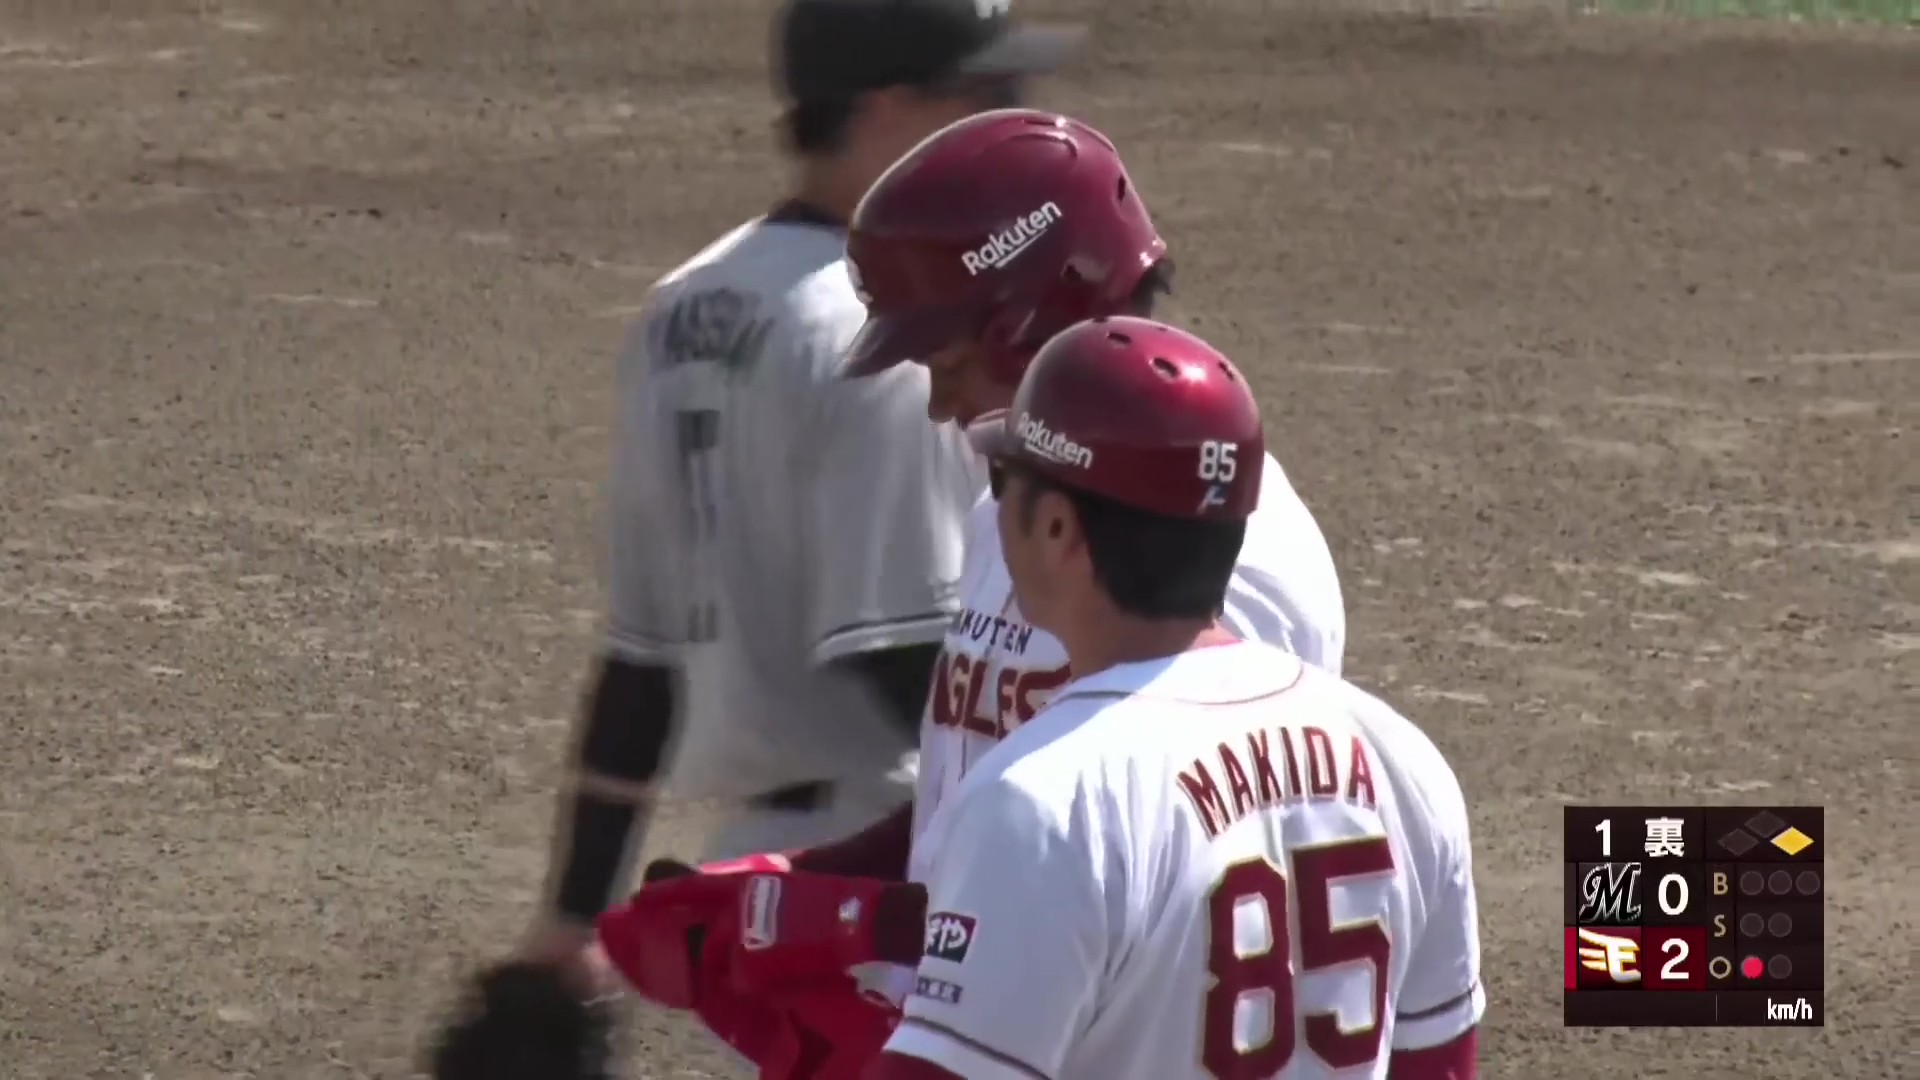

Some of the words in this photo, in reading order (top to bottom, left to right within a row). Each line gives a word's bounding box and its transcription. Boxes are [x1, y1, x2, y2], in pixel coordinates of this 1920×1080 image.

[961, 201, 1062, 276] Rakuten
[1017, 412, 1093, 469] Rakuten
[1199, 441, 1238, 482] 85
[1176, 726, 1376, 842] MAKIDA
[1201, 834, 1397, 1080] 85
